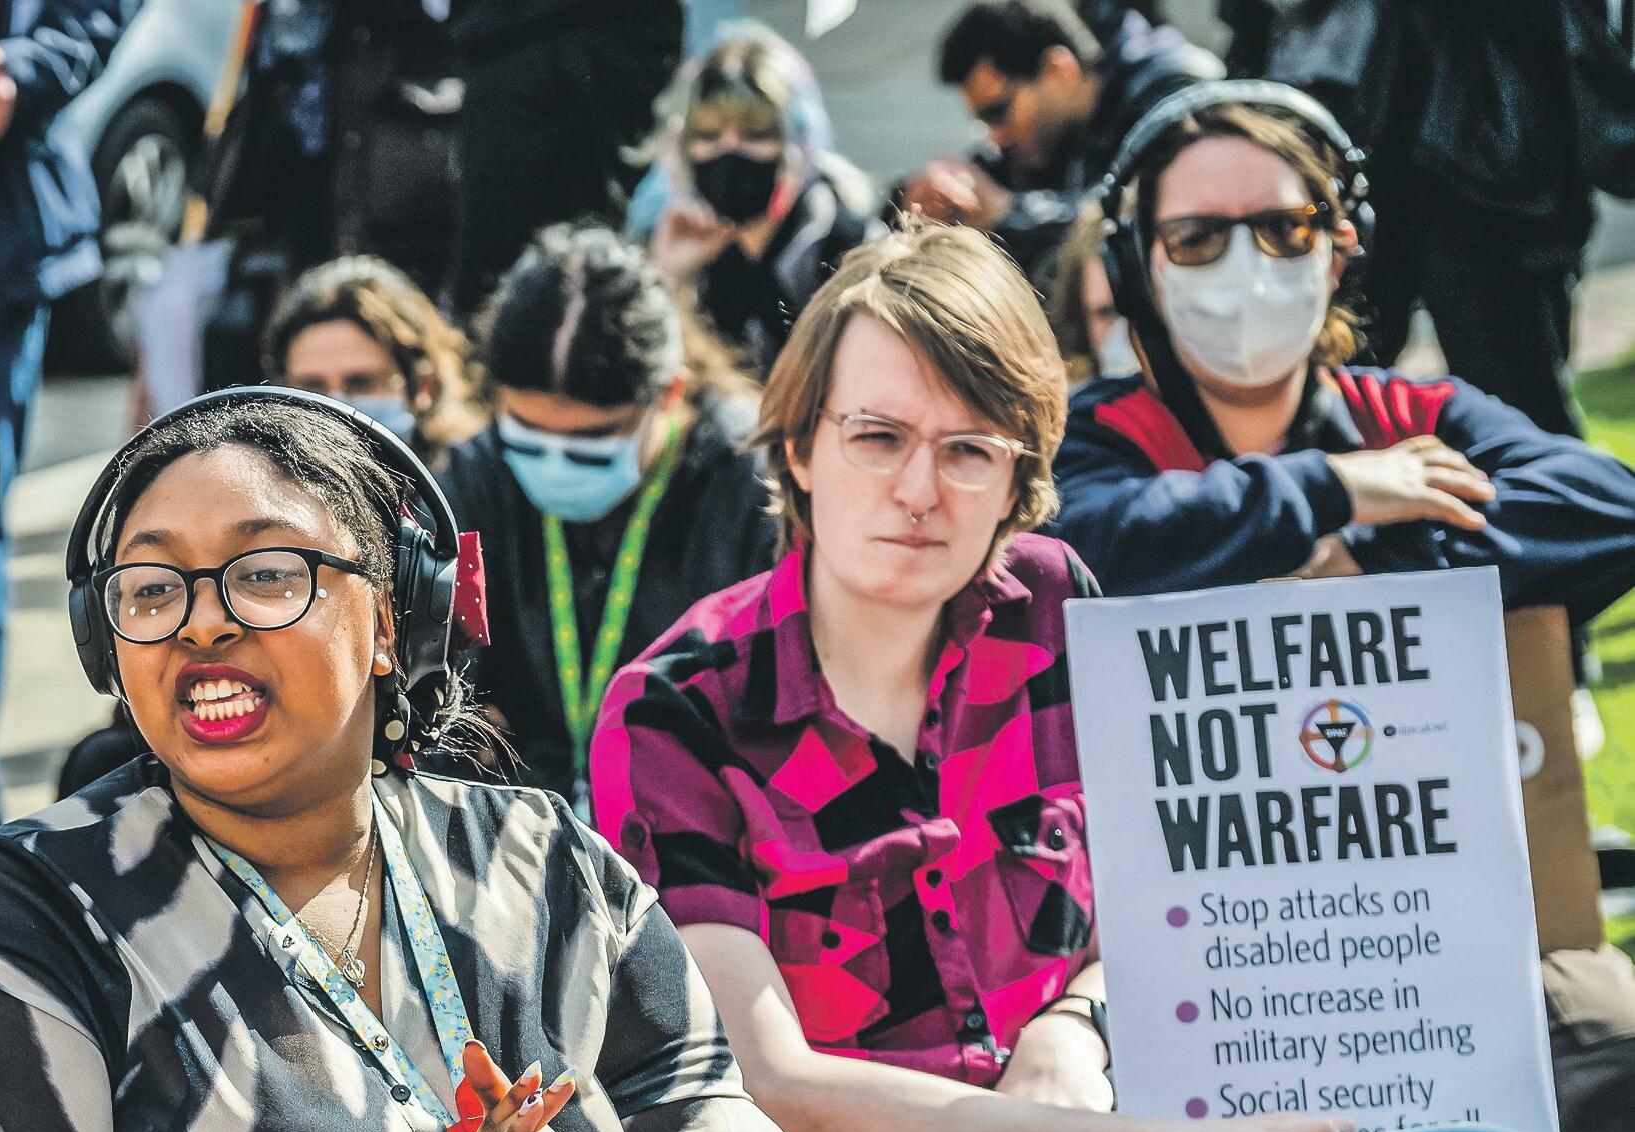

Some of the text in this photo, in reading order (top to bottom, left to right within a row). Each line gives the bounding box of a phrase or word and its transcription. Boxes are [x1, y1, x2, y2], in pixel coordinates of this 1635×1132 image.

[1137, 606, 1429, 701] WELFARE
[1149, 703, 1278, 787] NOT
[1154, 778, 1458, 872] WARFARE
[1201, 882, 1431, 930] Stop attacks on
[1205, 923, 1441, 970] disabled people
[1210, 978, 1420, 1021] No increase in
[1214, 1019, 1476, 1068] military spending
[1219, 1074, 1435, 1119] Social security
